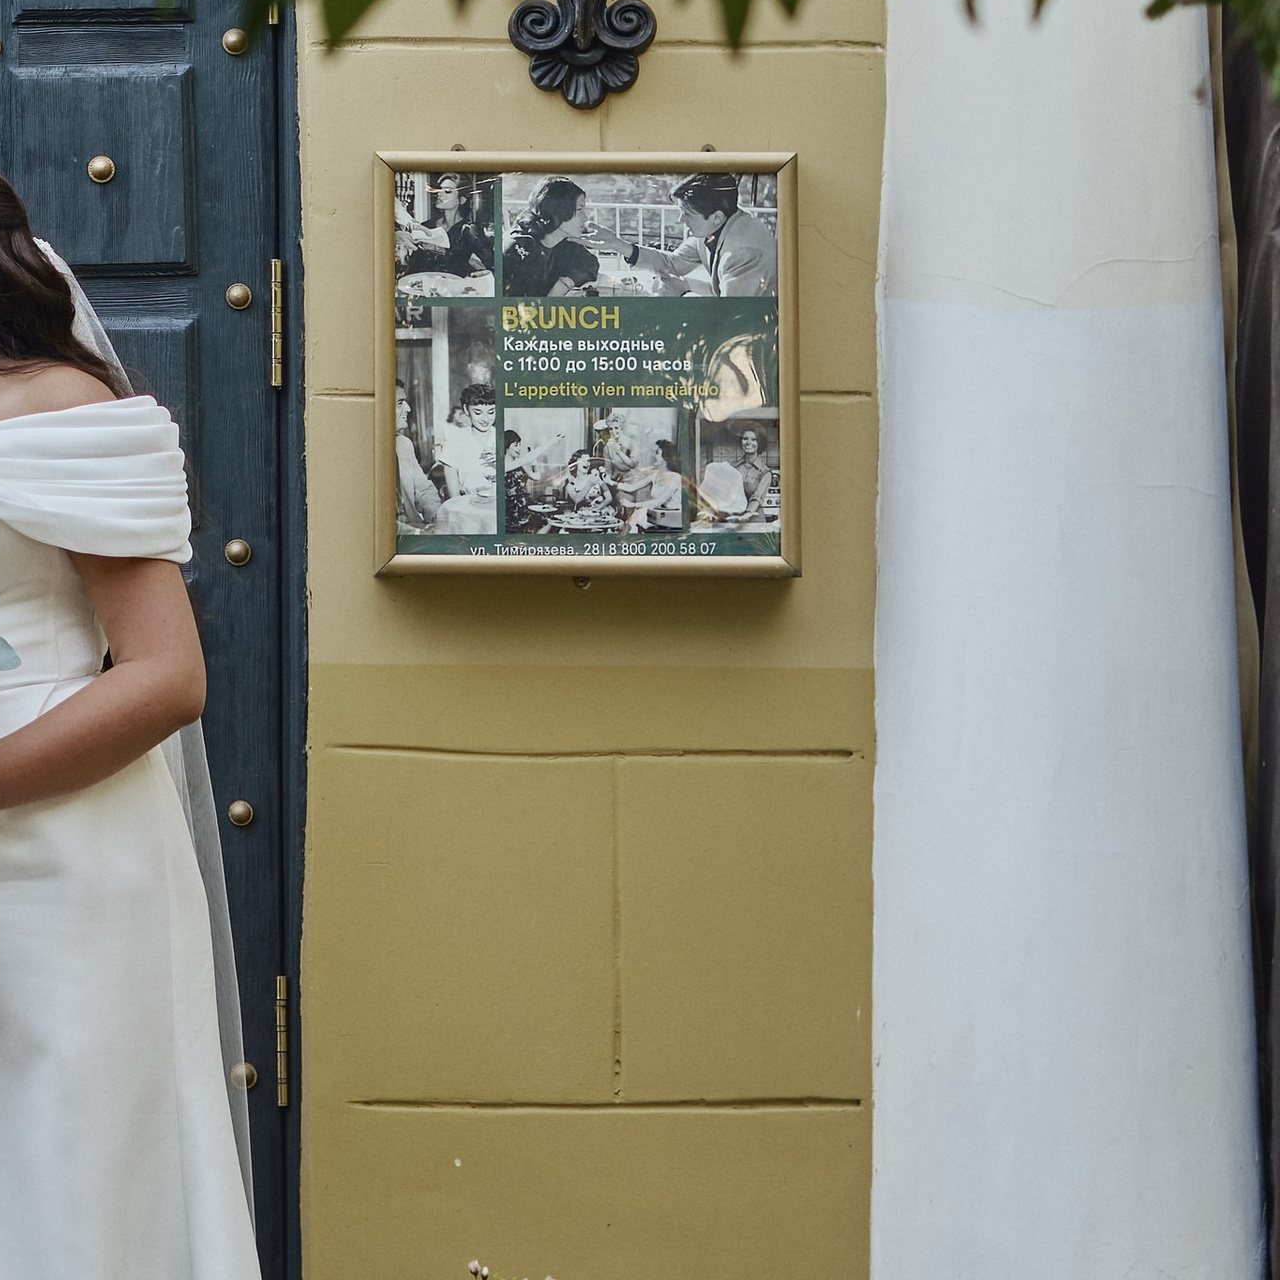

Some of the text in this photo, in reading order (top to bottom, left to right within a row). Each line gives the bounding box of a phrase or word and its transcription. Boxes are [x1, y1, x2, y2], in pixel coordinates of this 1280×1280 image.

[502, 305, 620, 329] BRUNCH
[503, 337, 665, 353] Каждые выходные
[503, 357, 692, 373] с 11:00 до 15:00 часов
[504, 382, 719, 400] L'appetito vien mangiando
[621, 543, 646, 555] 800
[650, 543, 675, 555] 200
[679, 543, 696, 555] 58
[700, 543, 717, 555] 07
